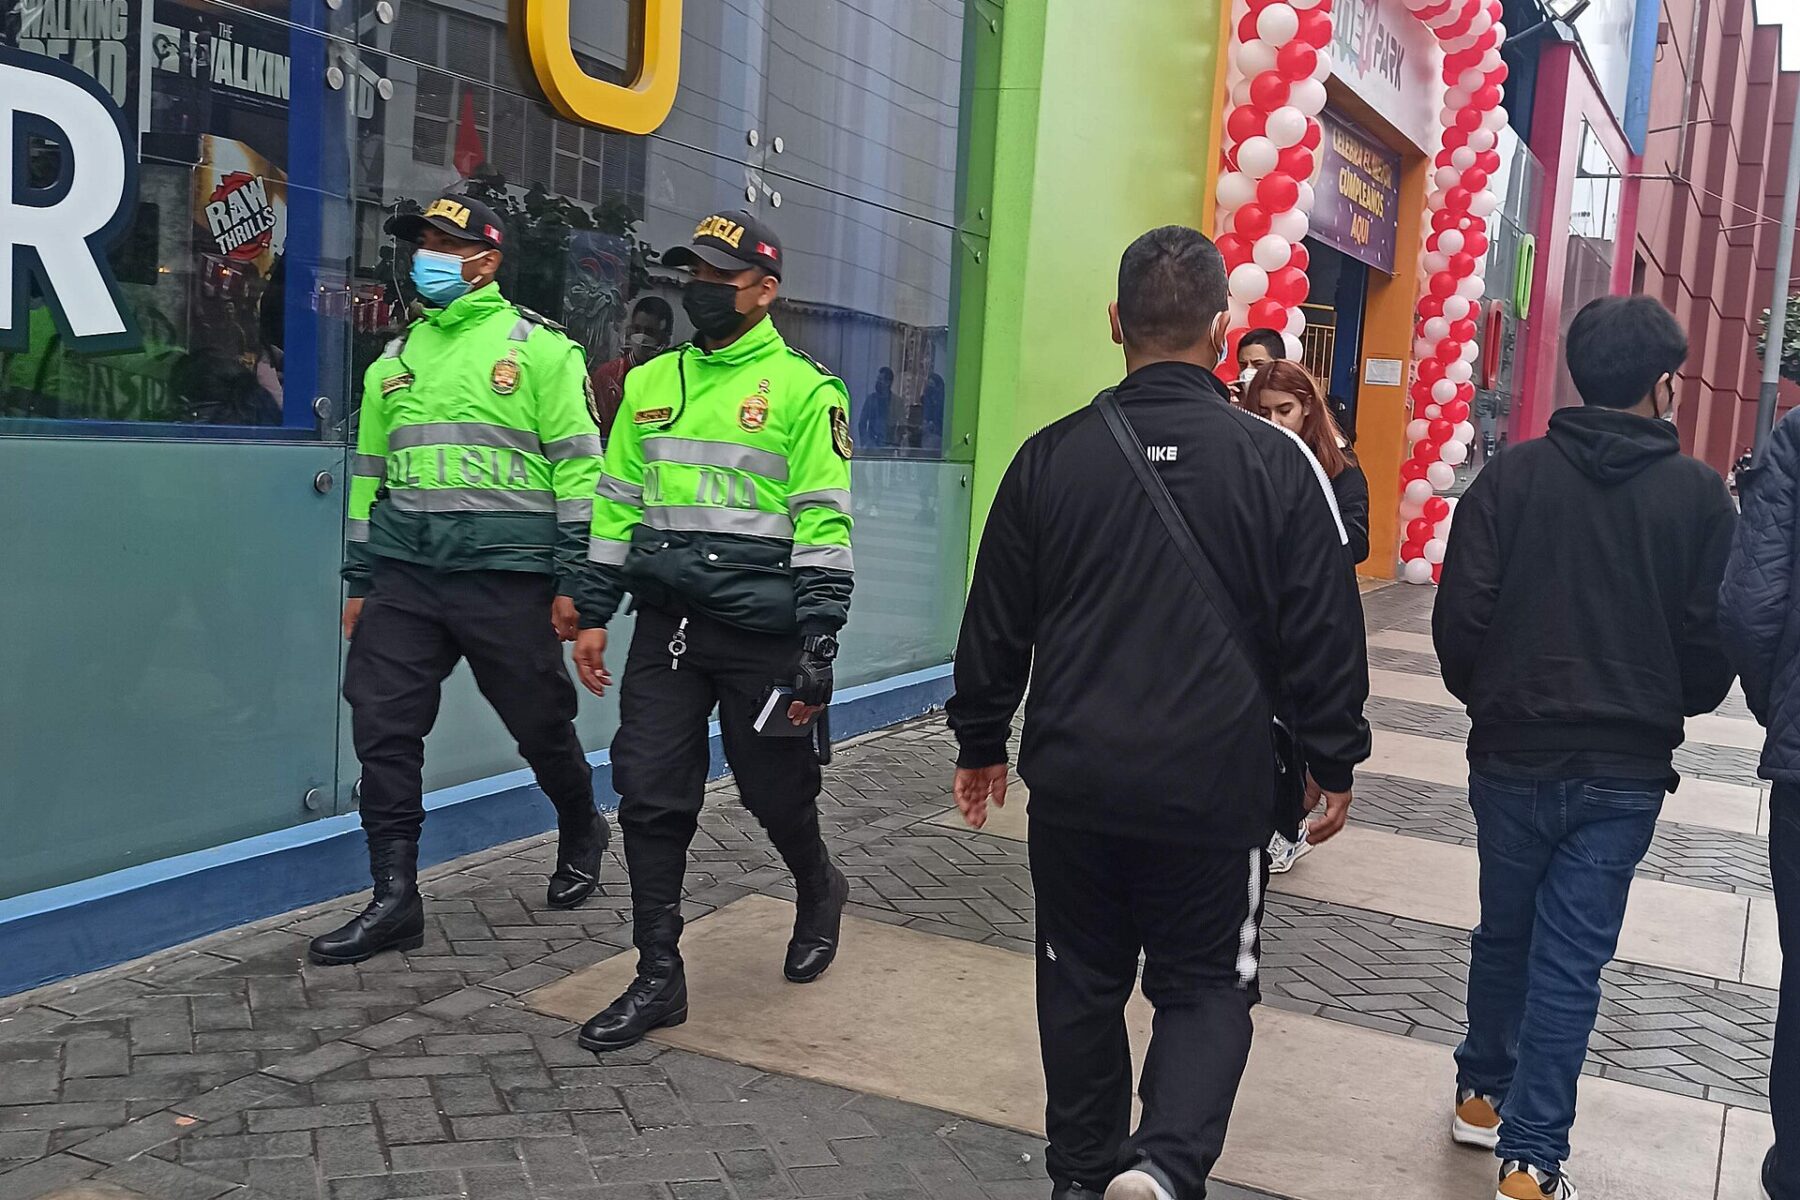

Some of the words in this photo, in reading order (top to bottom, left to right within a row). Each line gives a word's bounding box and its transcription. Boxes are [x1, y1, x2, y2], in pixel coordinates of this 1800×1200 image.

[218, 21, 234, 41] THE
[1373, 22, 1405, 92] PARK
[205, 176, 268, 237] RAW
[215, 206, 276, 255] THRILLS
